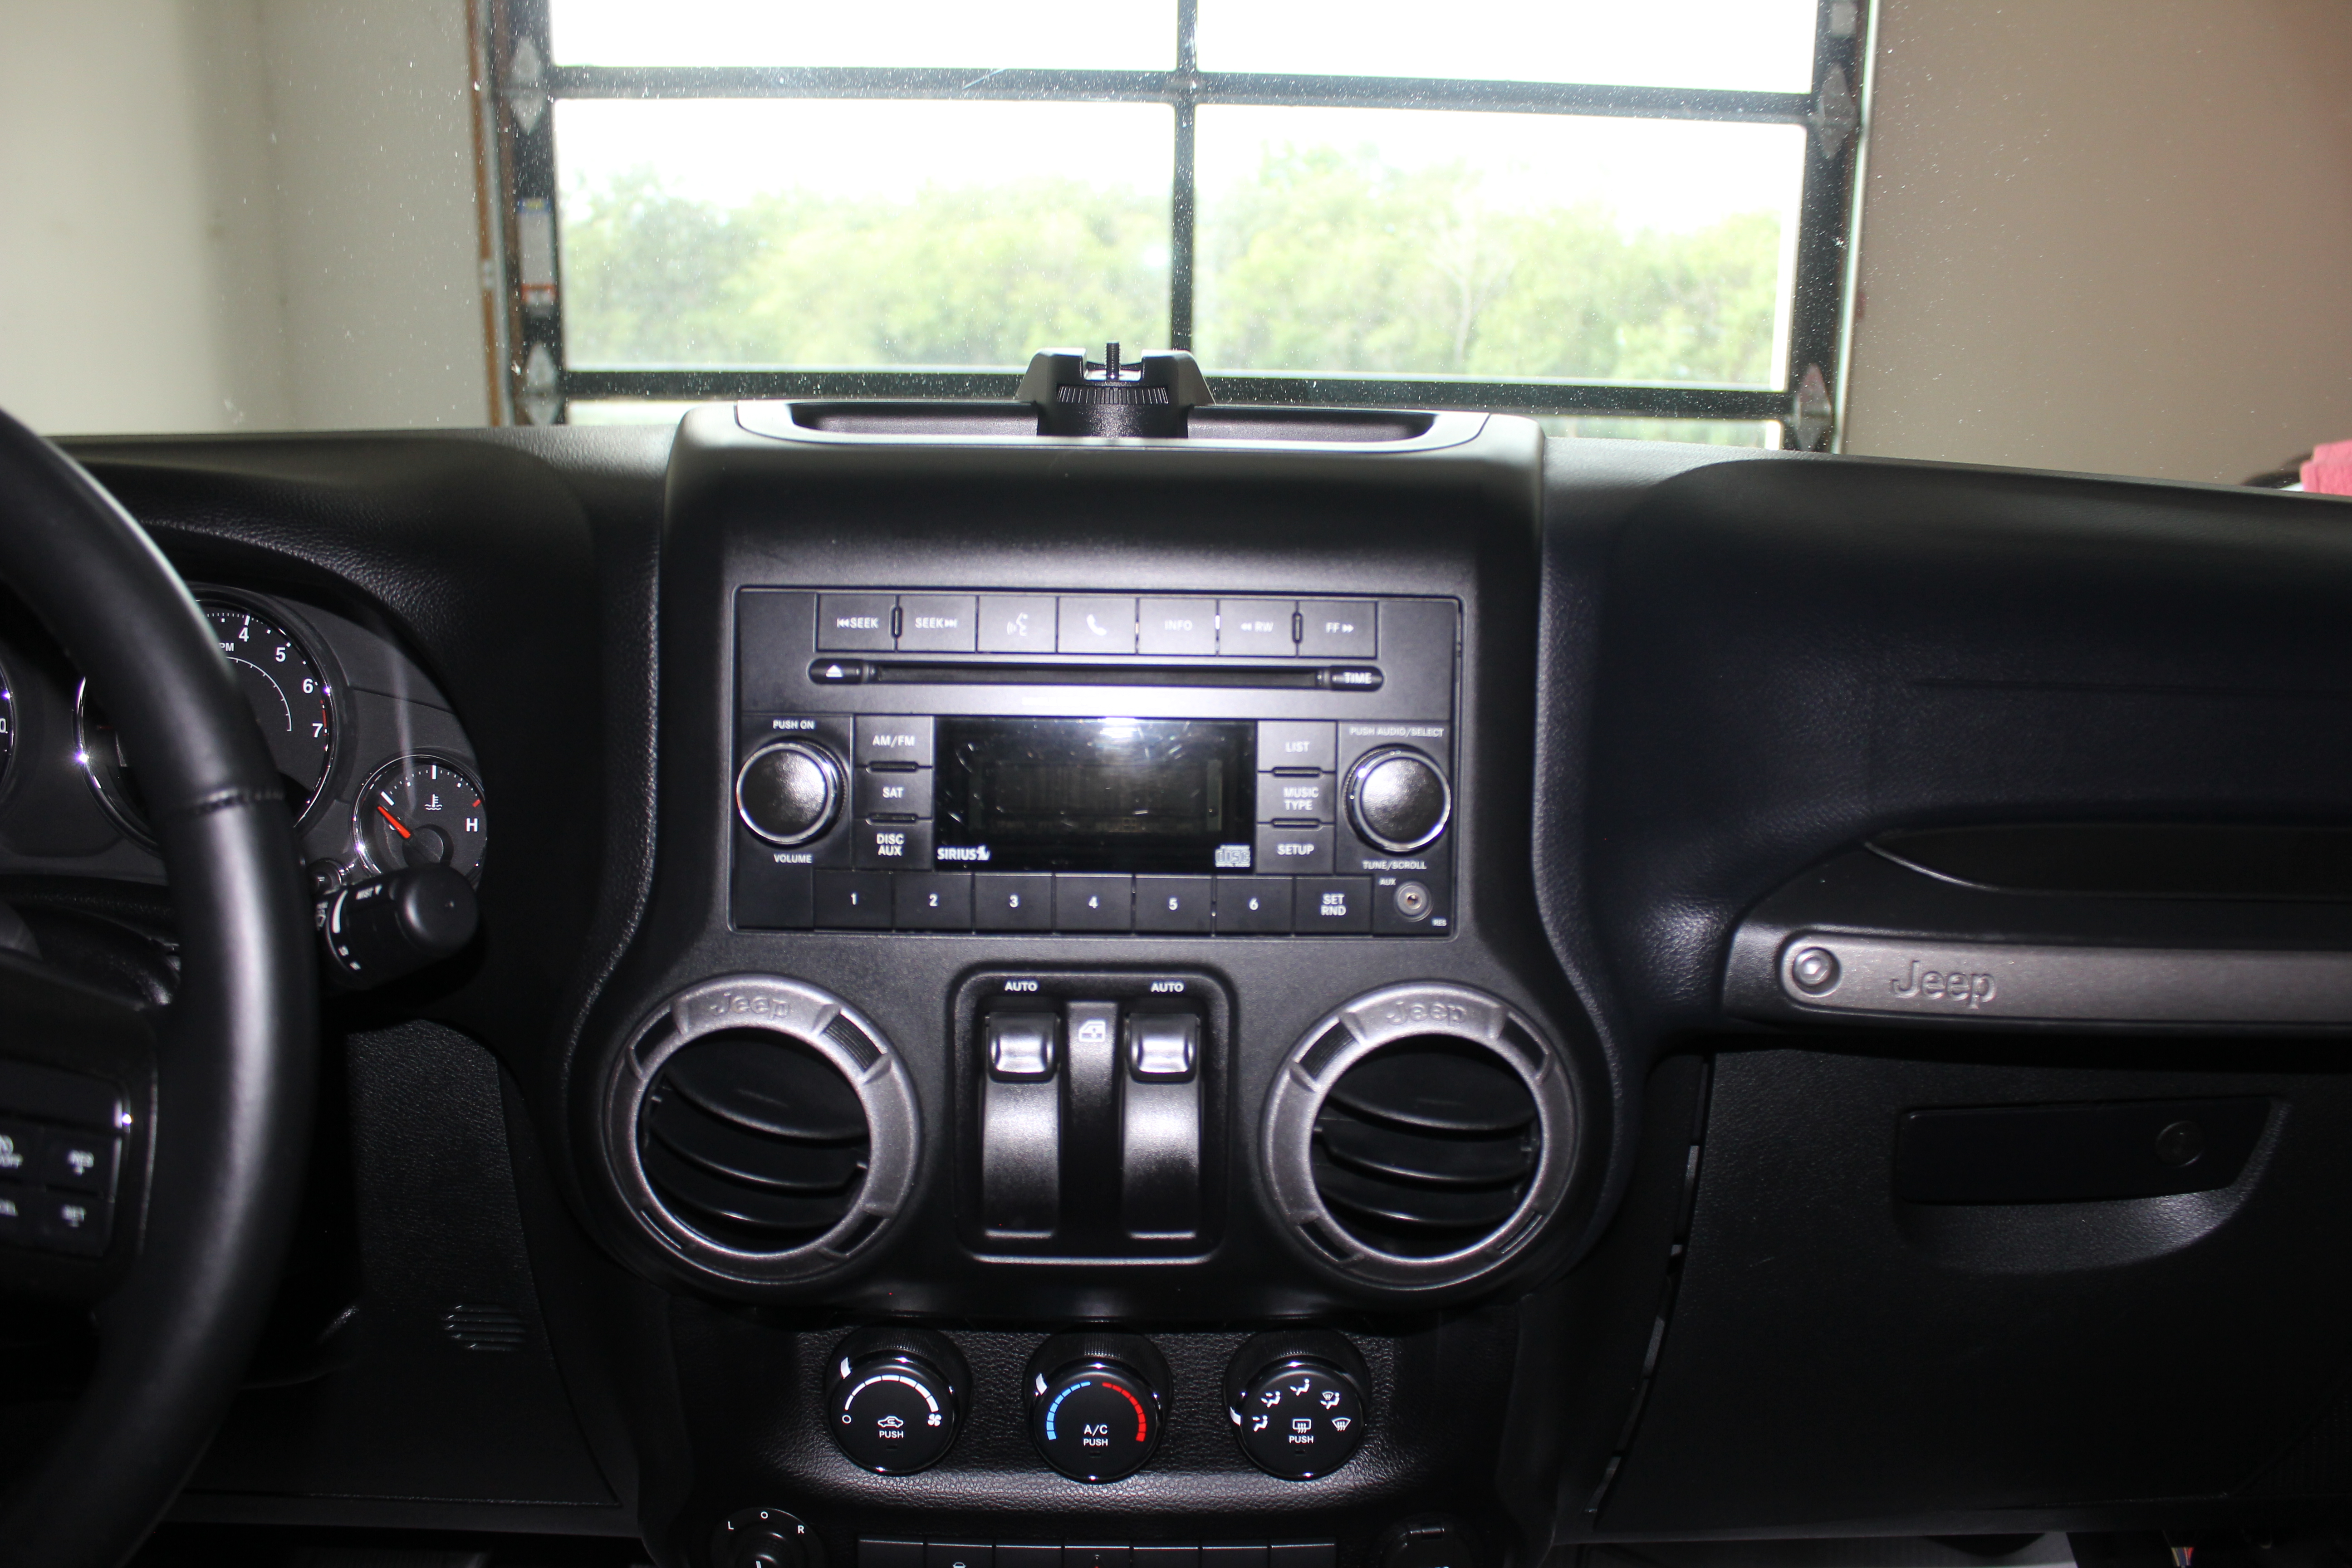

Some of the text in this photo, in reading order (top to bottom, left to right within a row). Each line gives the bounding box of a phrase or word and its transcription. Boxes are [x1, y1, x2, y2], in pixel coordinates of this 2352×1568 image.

[850, 617, 879, 629] SEEK
[915, 617, 944, 629] SEEK
[1164, 620, 1193, 632] INFO
[1254, 621, 1274, 632] RW
[1325, 622, 1340, 633] FF
[239, 627, 250, 642] 4
[219, 642, 234, 652] PM
[275, 647, 286, 662] 5
[1344, 672, 1372, 684] TIME
[303, 678, 314, 694] 6
[312, 723, 323, 738] 7
[773, 720, 815, 730] PUSH ON
[1349, 726, 1444, 738] PUSH AUDIO/SELECT
[872, 735, 916, 748] AM/FM
[1285, 741, 1310, 752] LIST
[882, 786, 904, 799] SAT
[1283, 786, 1318, 798] MUSIC
[1284, 799, 1313, 810] TYPE
[466, 818, 478, 832] H
[877, 833, 904, 845] DISC
[878, 845, 902, 856] AUX
[937, 847, 976, 861] SIRIUS
[1277, 843, 1314, 855] SETUP
[774, 853, 812, 863] VOLUME
[1362, 860, 1427, 871] TUNE/SCROLL
[1379, 877, 1396, 886] AUX
[851, 893, 857, 905] 1
[929, 893, 938, 906] 2
[1009, 894, 1019, 908] 3
[1088, 896, 1098, 909] 4
[1169, 897, 1178, 910] 5
[1249, 898, 1259, 910] 6
[1323, 893, 1345, 905] SET
[1321, 904, 1347, 916] RND
[1004, 981, 1038, 991] AUTO
[1151, 981, 1184, 992] AUTO
[1890, 960, 1997, 1005] Jeep
[709, 992, 790, 1020] Jeep
[1386, 1000, 1467, 1026] Jeep
[879, 1430, 904, 1438] PUSH
[1084, 1424, 1108, 1436] A/C
[1083, 1438, 1108, 1446] PUSH
[1289, 1435, 1314, 1443] PUSH
[728, 1521, 734, 1530] L
[798, 1525, 804, 1534] R
